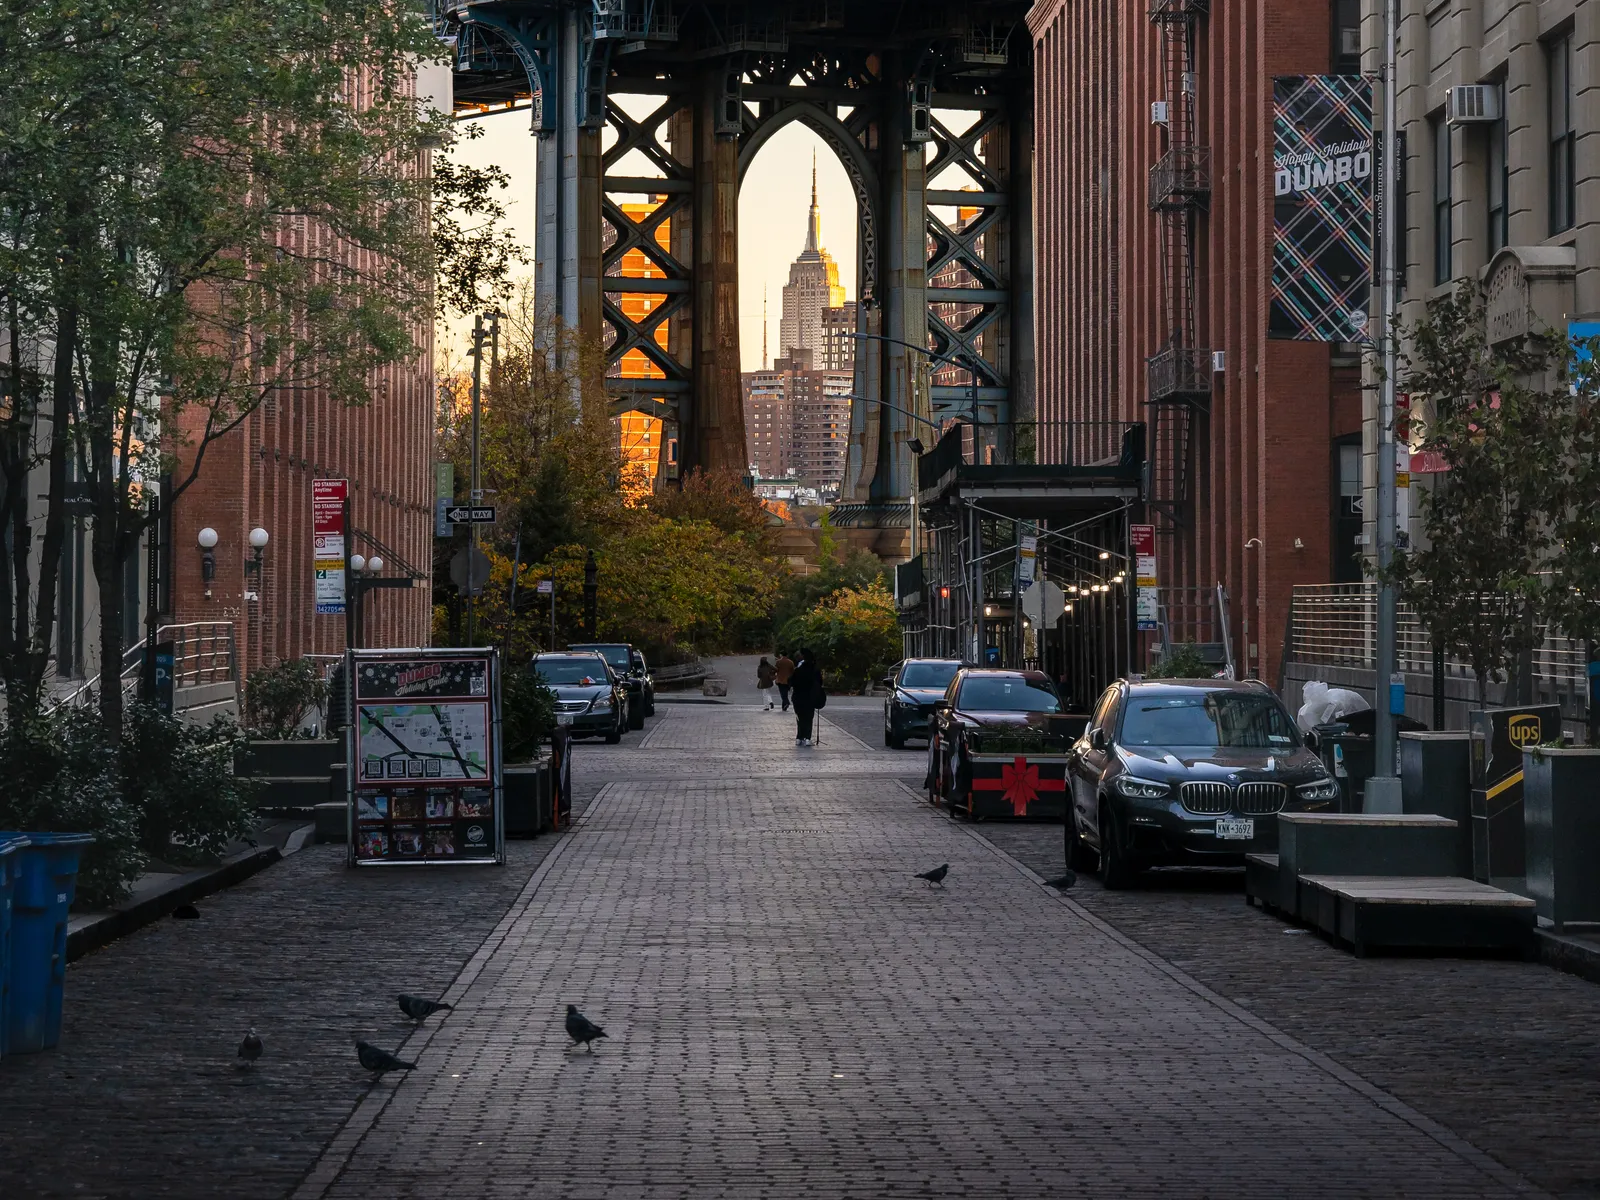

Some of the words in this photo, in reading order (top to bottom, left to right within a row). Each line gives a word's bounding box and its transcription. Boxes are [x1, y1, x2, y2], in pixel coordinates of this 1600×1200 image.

[1274, 150, 1316, 169] Happy
[1318, 138, 1372, 158] Holidays
[1274, 151, 1371, 197] DUMBO
[453, 510, 469, 519] ONE
[473, 510, 489, 519] WAY
[318, 569, 325, 579] 2
[990, 653, 996, 662] P
[155, 667, 167, 687] P
[398, 663, 442, 687] DUMBO
[394, 681, 428, 697] Holiday
[1511, 725, 1539, 746] ups
